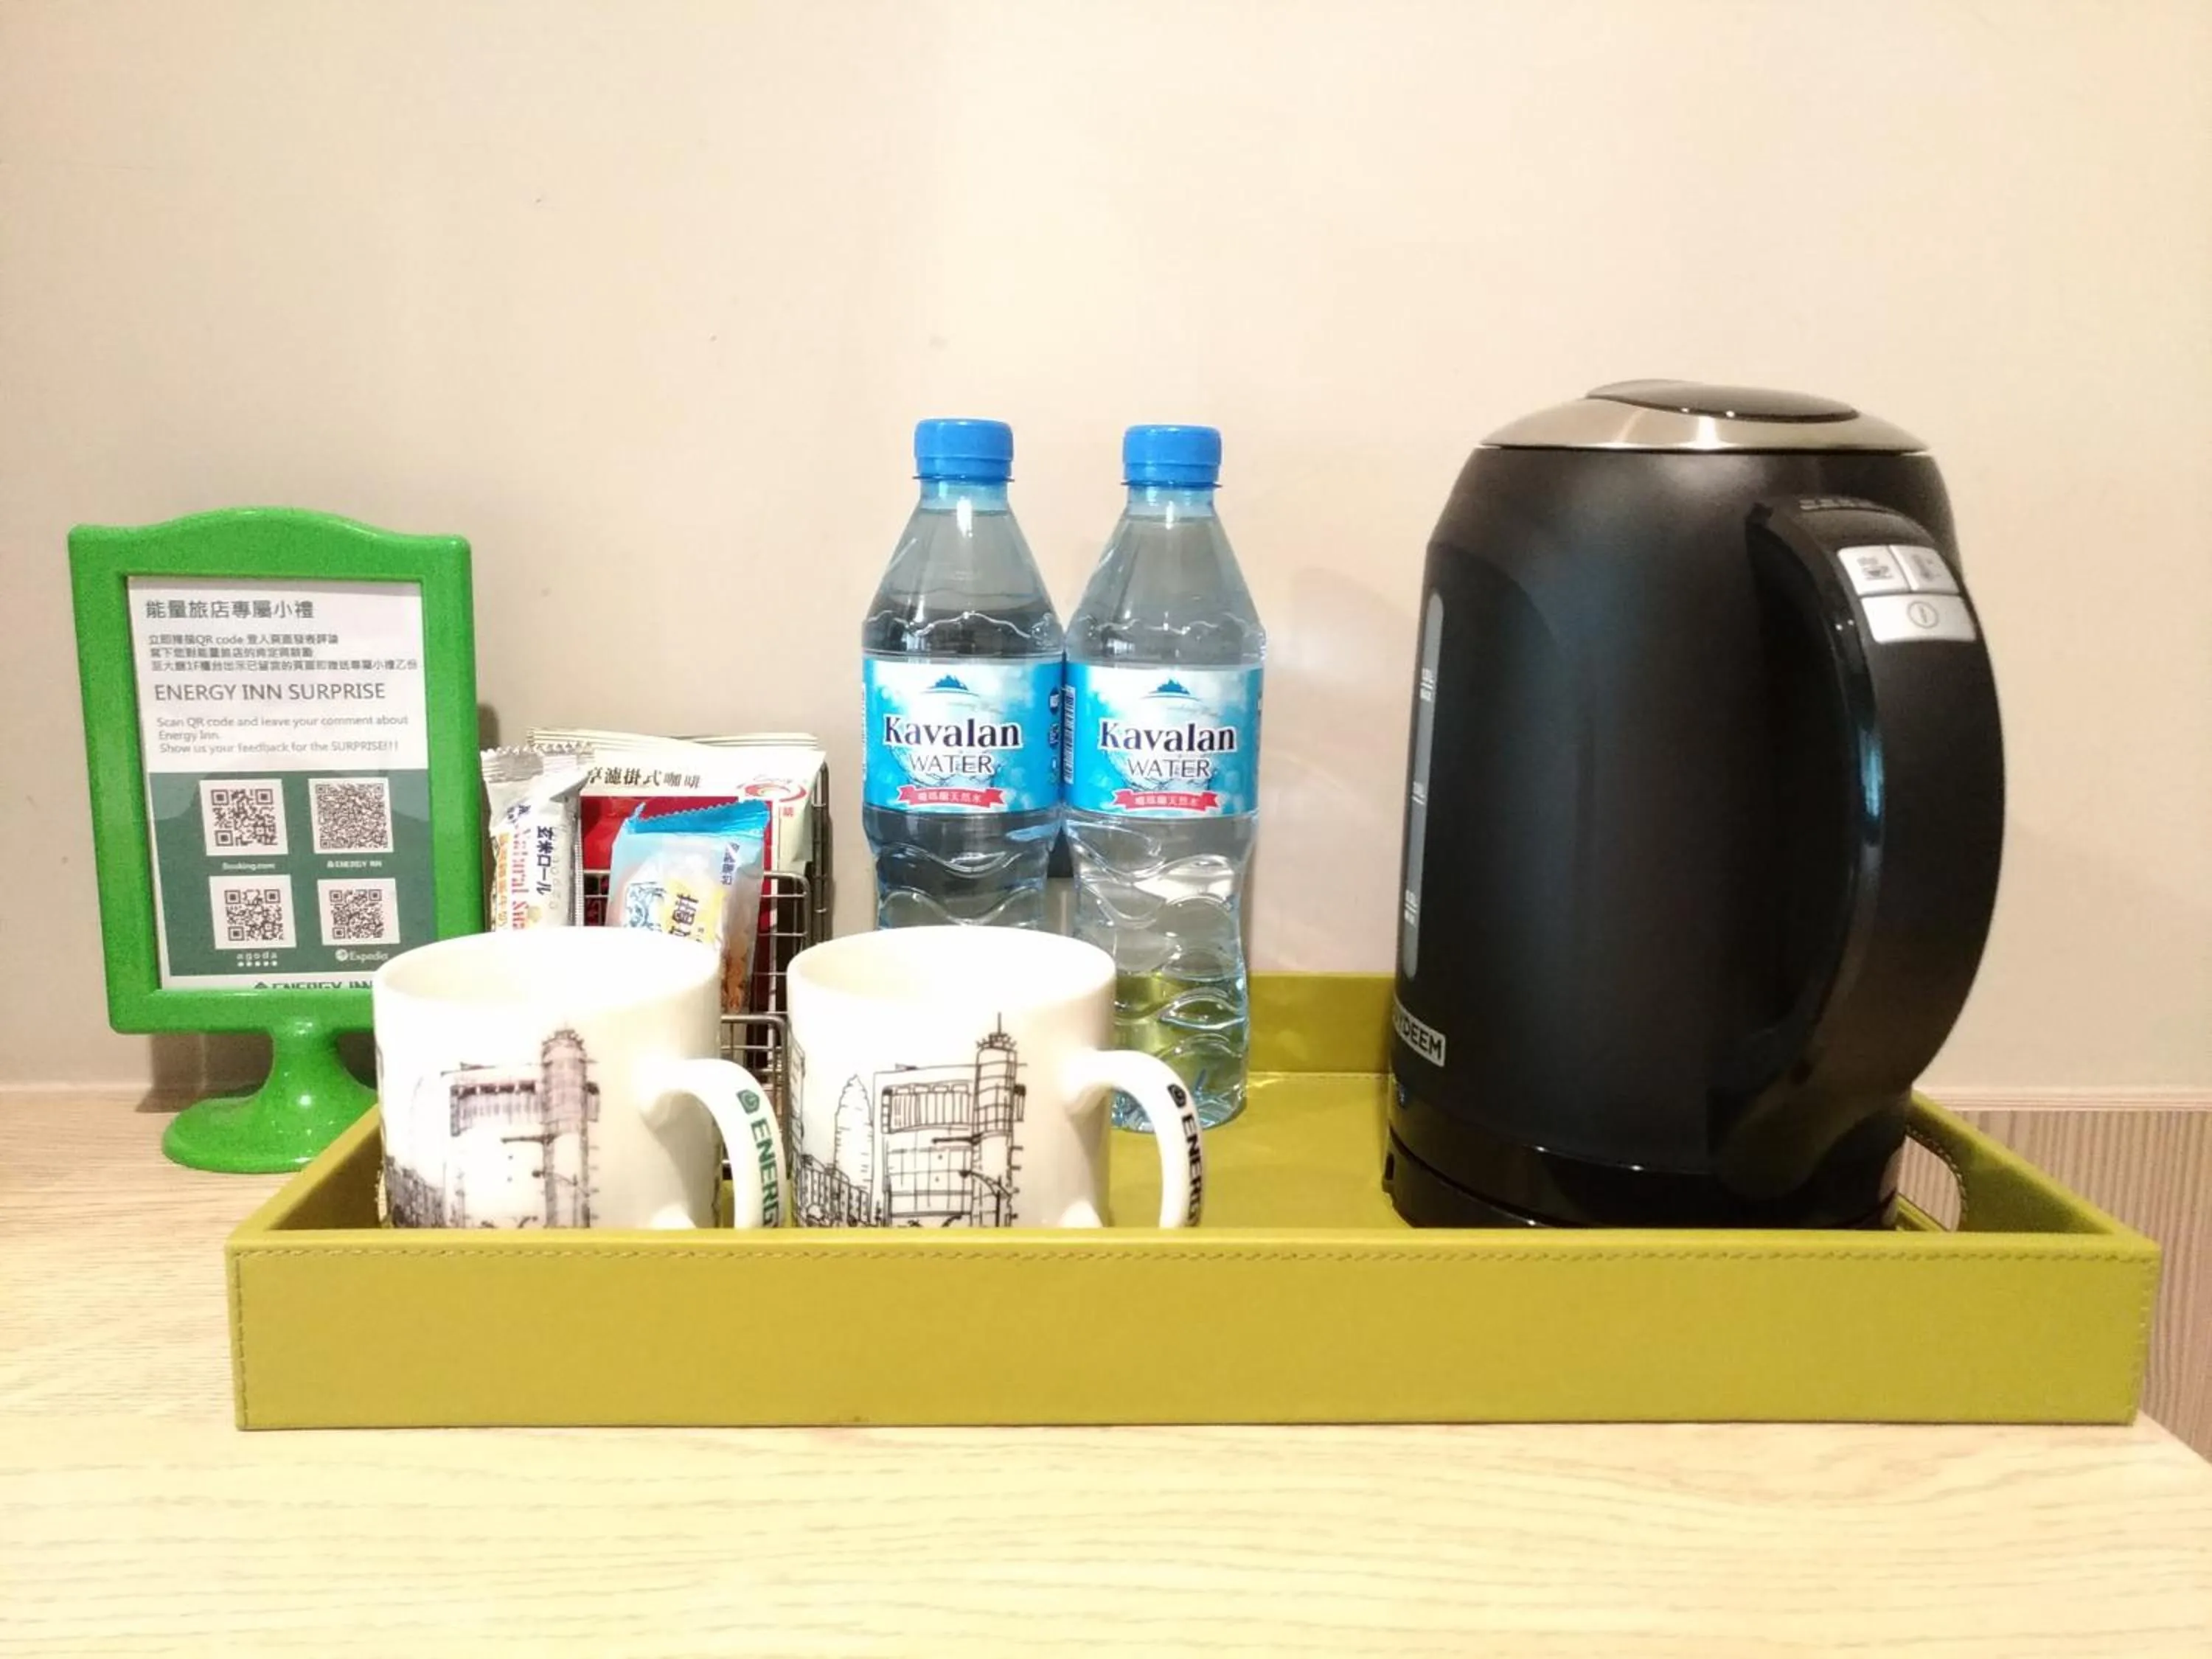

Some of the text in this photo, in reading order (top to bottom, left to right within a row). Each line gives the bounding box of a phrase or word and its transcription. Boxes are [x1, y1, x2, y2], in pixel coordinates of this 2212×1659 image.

[146, 599, 313, 619] 能量旅店專屬小禮
[154, 683, 386, 700] ENERGY INN SURPRISE
[157, 714, 408, 728] Scan QR code and leave your comment about
[159, 731, 197, 742] Energy
[885, 716, 1020, 748] Kavalan
[1101, 720, 1235, 752] Kavalan
[160, 742, 191, 753] Show
[209, 745, 234, 755] your
[237, 742, 290, 753] feedback
[291, 742, 307, 751] for
[310, 742, 329, 751] the
[909, 754, 993, 773] WATER
[1127, 758, 1211, 778] WATER
[237, 952, 278, 961] agoda
[349, 950, 389, 963] Expedia
[751, 1118, 780, 1228] ENERG
[1181, 1113, 1203, 1228] ENERG
